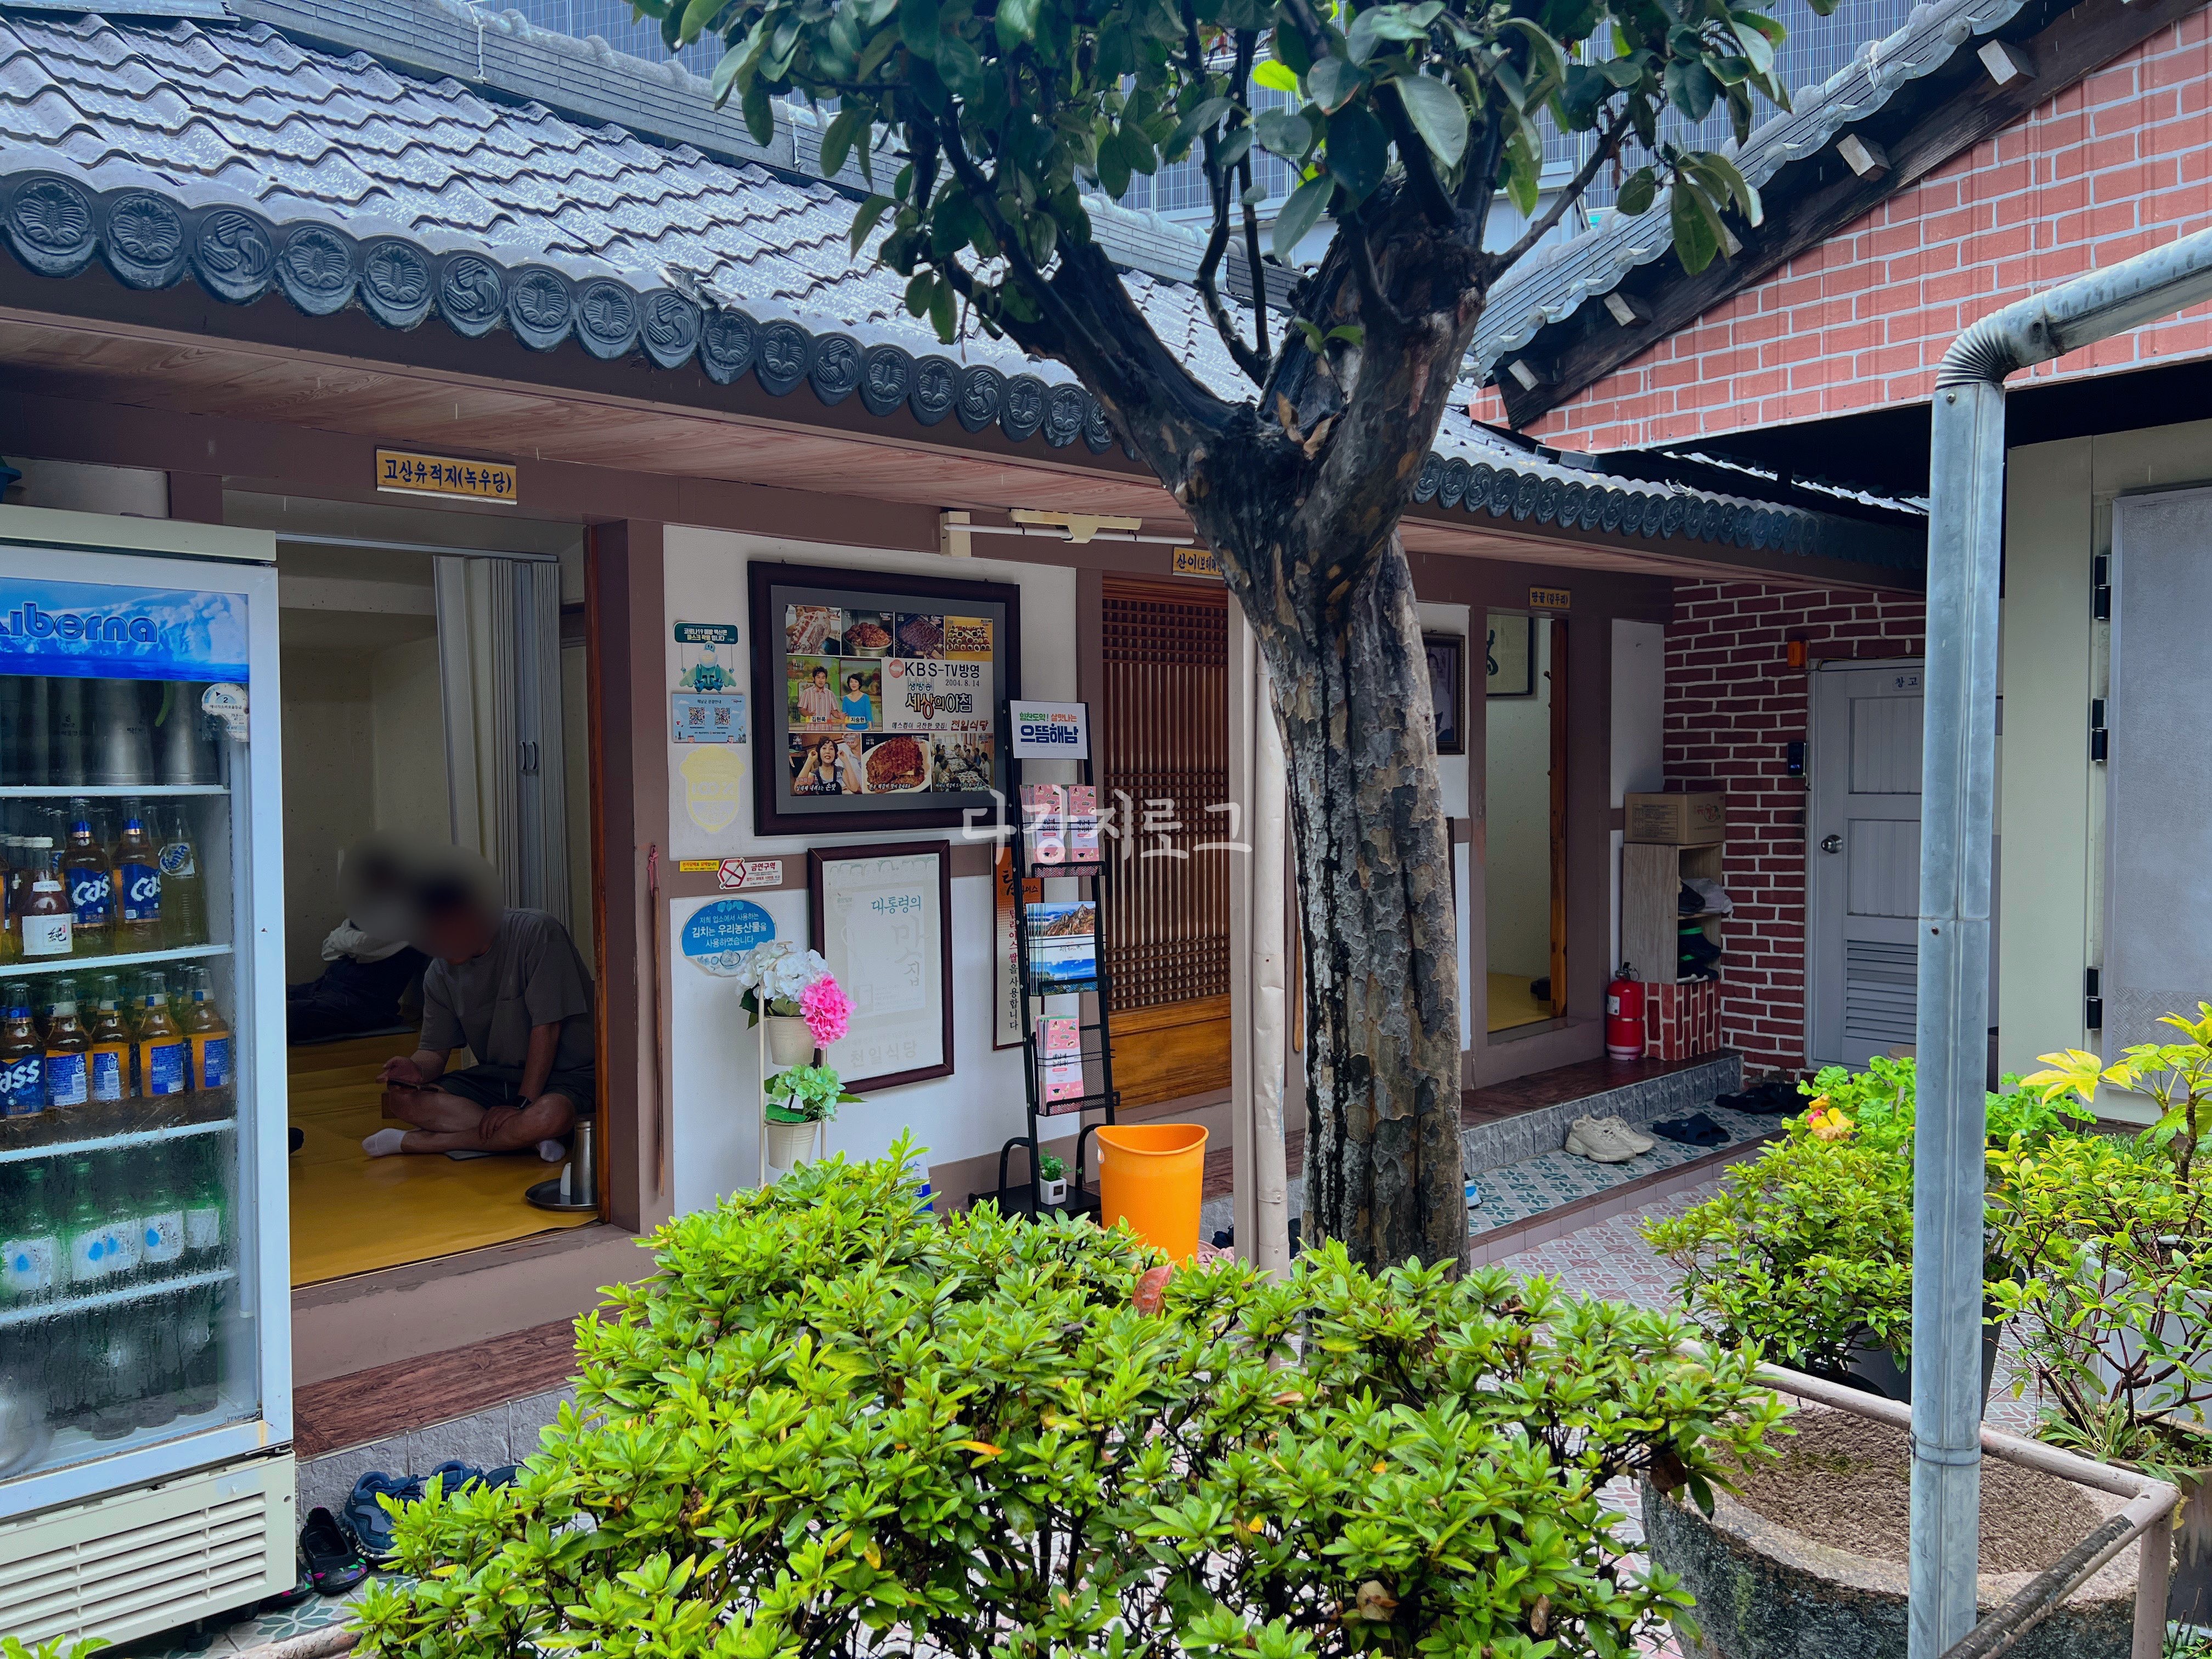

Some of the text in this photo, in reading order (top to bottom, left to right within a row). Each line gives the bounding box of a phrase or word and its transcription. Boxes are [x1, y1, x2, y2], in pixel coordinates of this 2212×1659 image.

[384, 459, 512, 493] 고산유적지(녹우당)
[909, 682, 932, 691] 생방송
[1019, 712, 1077, 722] 힘찬도약! 살맛나는
[751, 862, 776, 871] 금연구역
[871, 895, 922, 915] 대통령의
[713, 915, 735, 923] 업소에서
[737, 912, 759, 921] 사용하는
[692, 922, 767, 938] 김치는 우리농산물을
[706, 936, 754, 948] 사용하였습니다
[0, 1060, 40, 1093] ass
